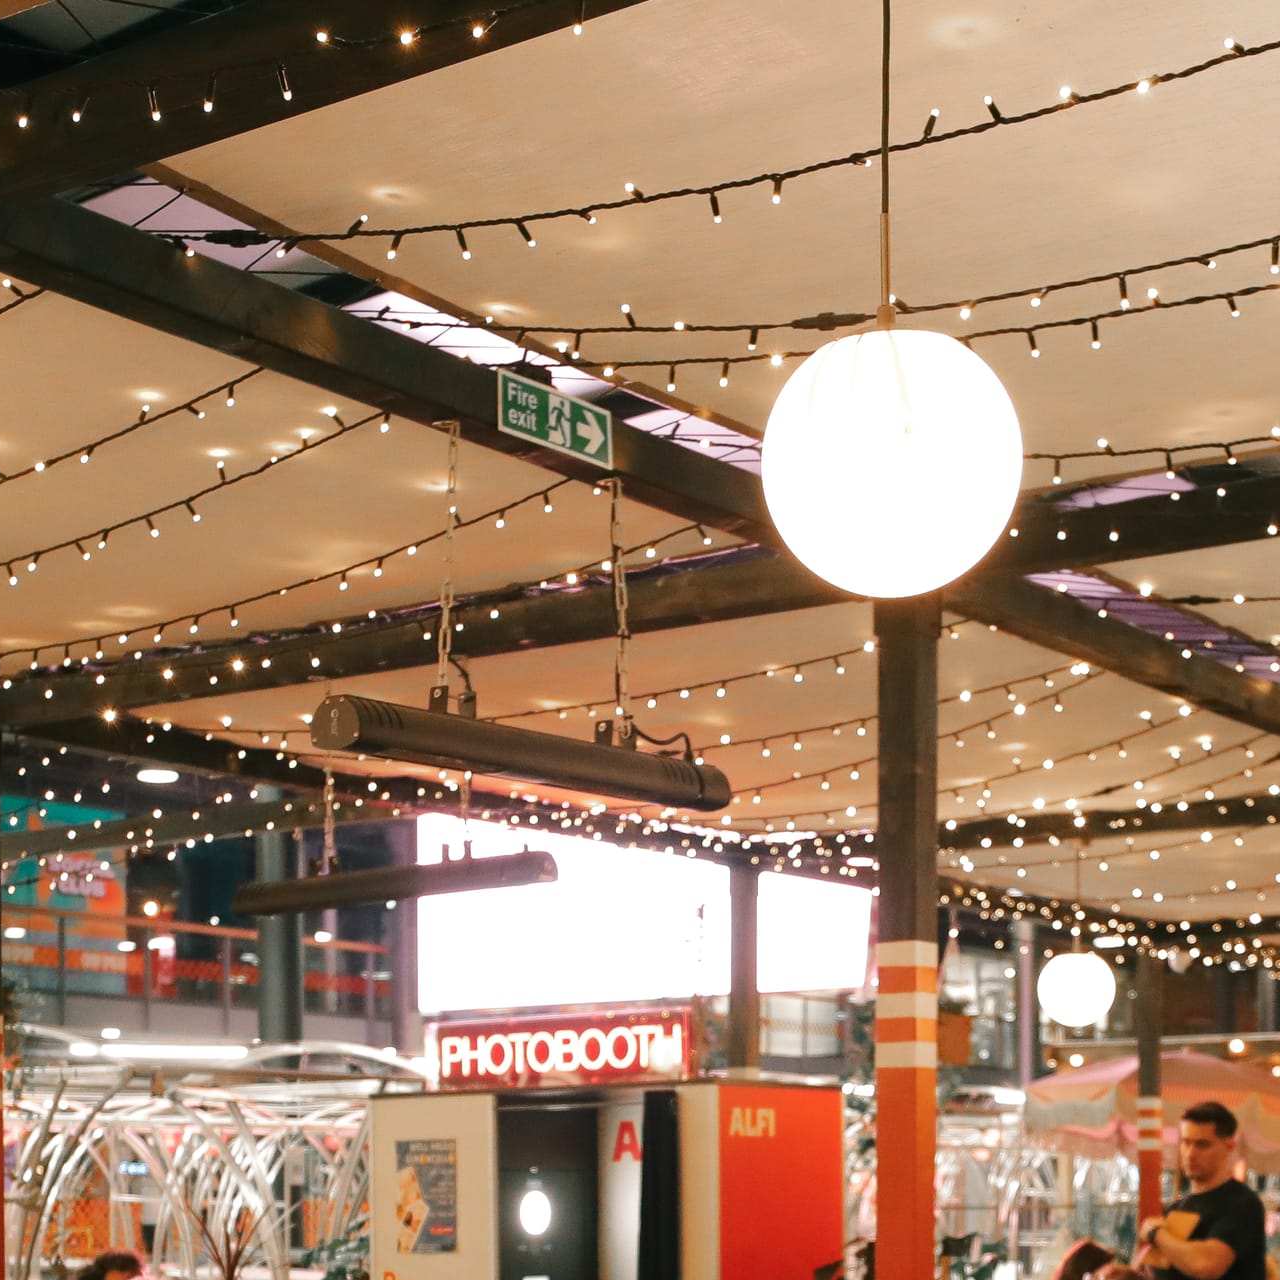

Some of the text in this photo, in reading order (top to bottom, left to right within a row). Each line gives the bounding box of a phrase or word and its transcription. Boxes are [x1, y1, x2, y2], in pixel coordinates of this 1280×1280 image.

[507, 382, 538, 410] Fire
[508, 407, 537, 432] exit
[441, 1023, 682, 1078] PHOTOBOOTH
[729, 1107, 776, 1137] ALFI
